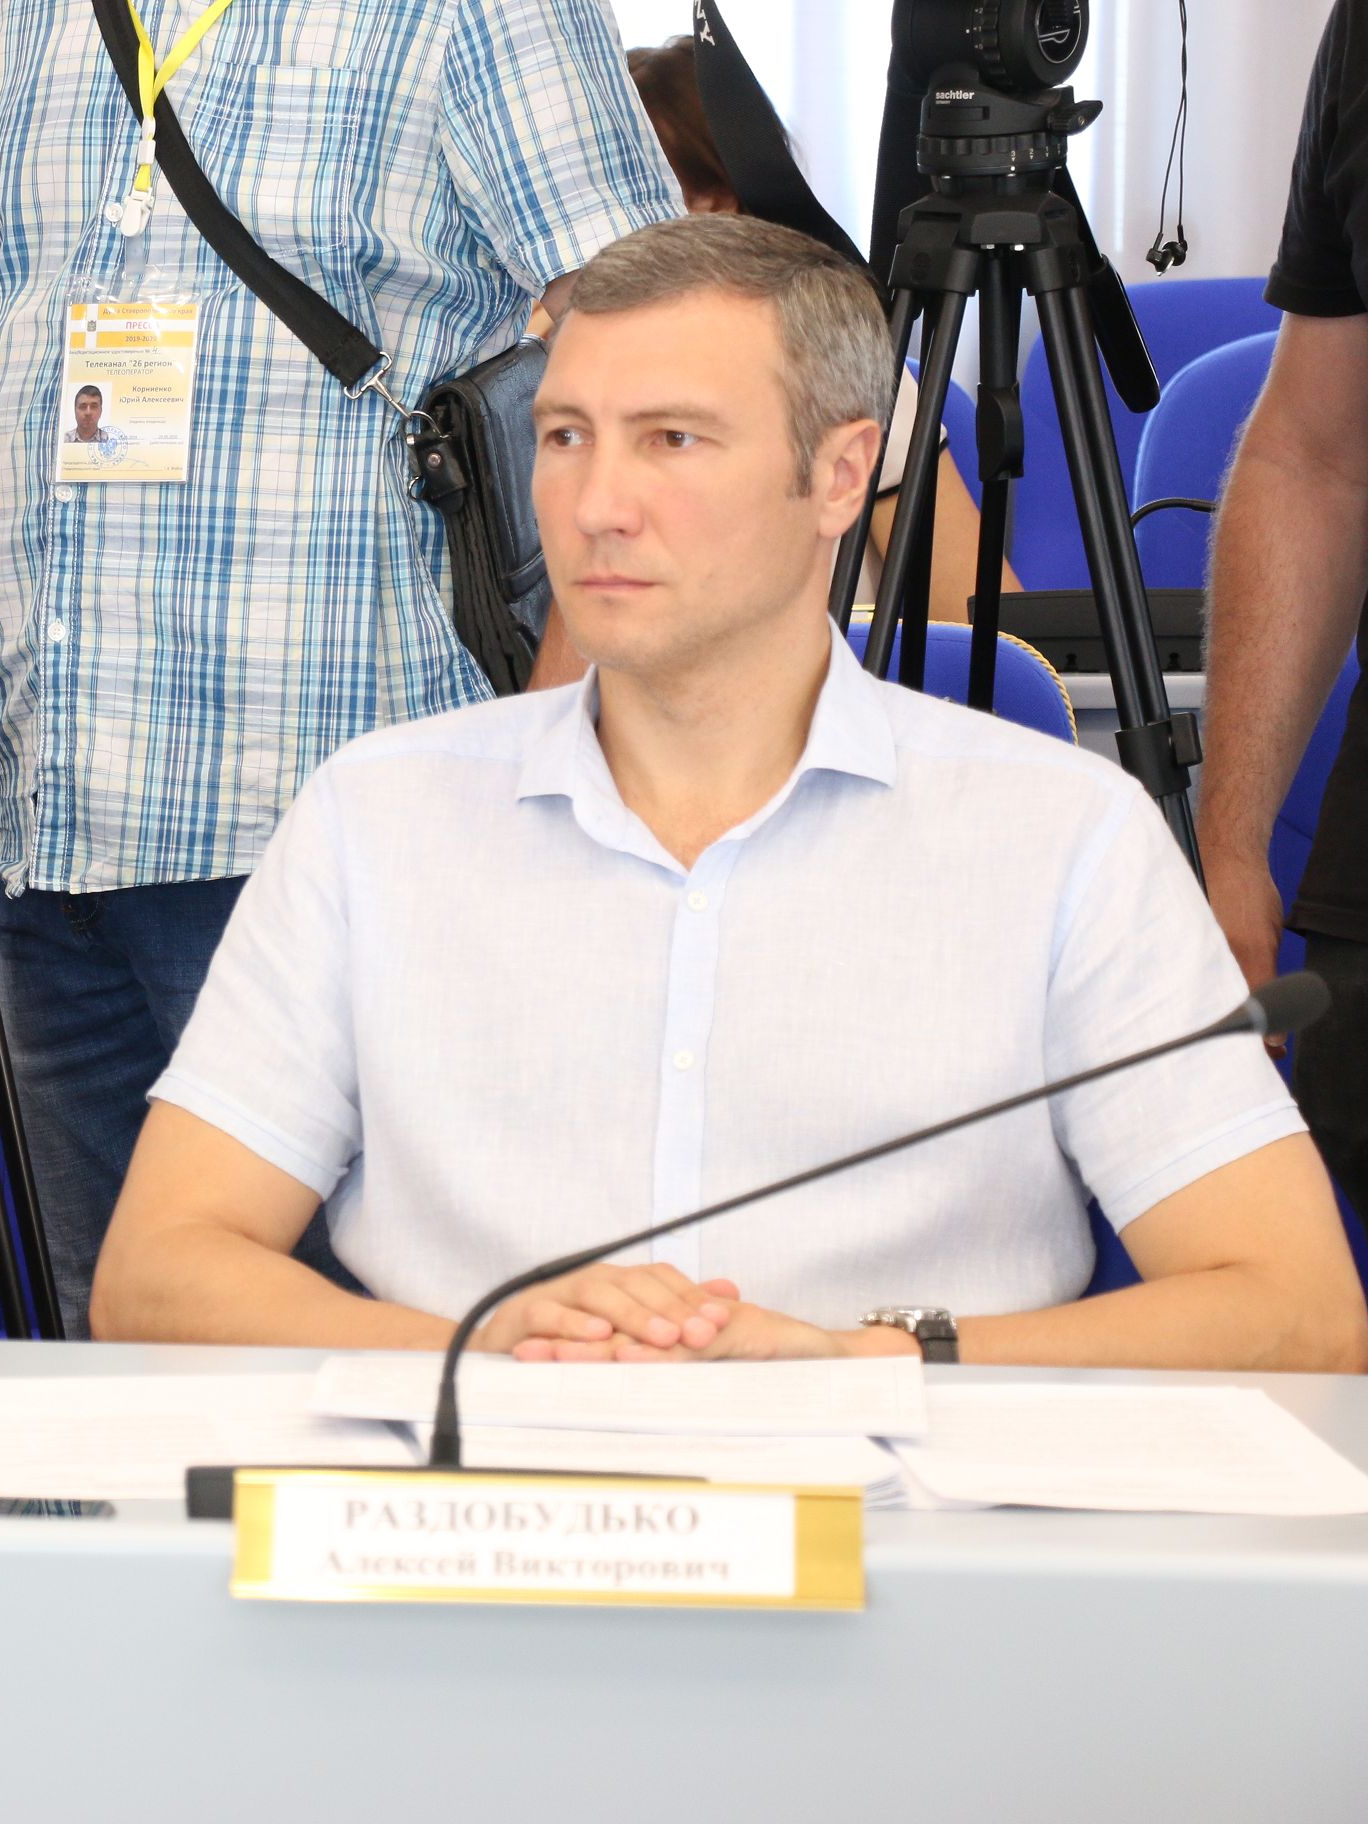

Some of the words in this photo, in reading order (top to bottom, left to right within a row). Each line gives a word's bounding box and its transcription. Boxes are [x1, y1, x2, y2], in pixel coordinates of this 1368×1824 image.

[935, 90, 975, 100] sachtler
[85, 360, 127, 368] Телеканал
[106, 368, 154, 376] ТЕЛЕОПЕРАТОР
[132, 385, 172, 393] Корниенко
[119, 395, 140, 404] Юрий
[142, 395, 184, 404] Алексеевич
[341, 1497, 702, 1537] РАЗДОБУДЬКО
[320, 1546, 478, 1579] Алексей
[493, 1549, 731, 1587] Викторович
